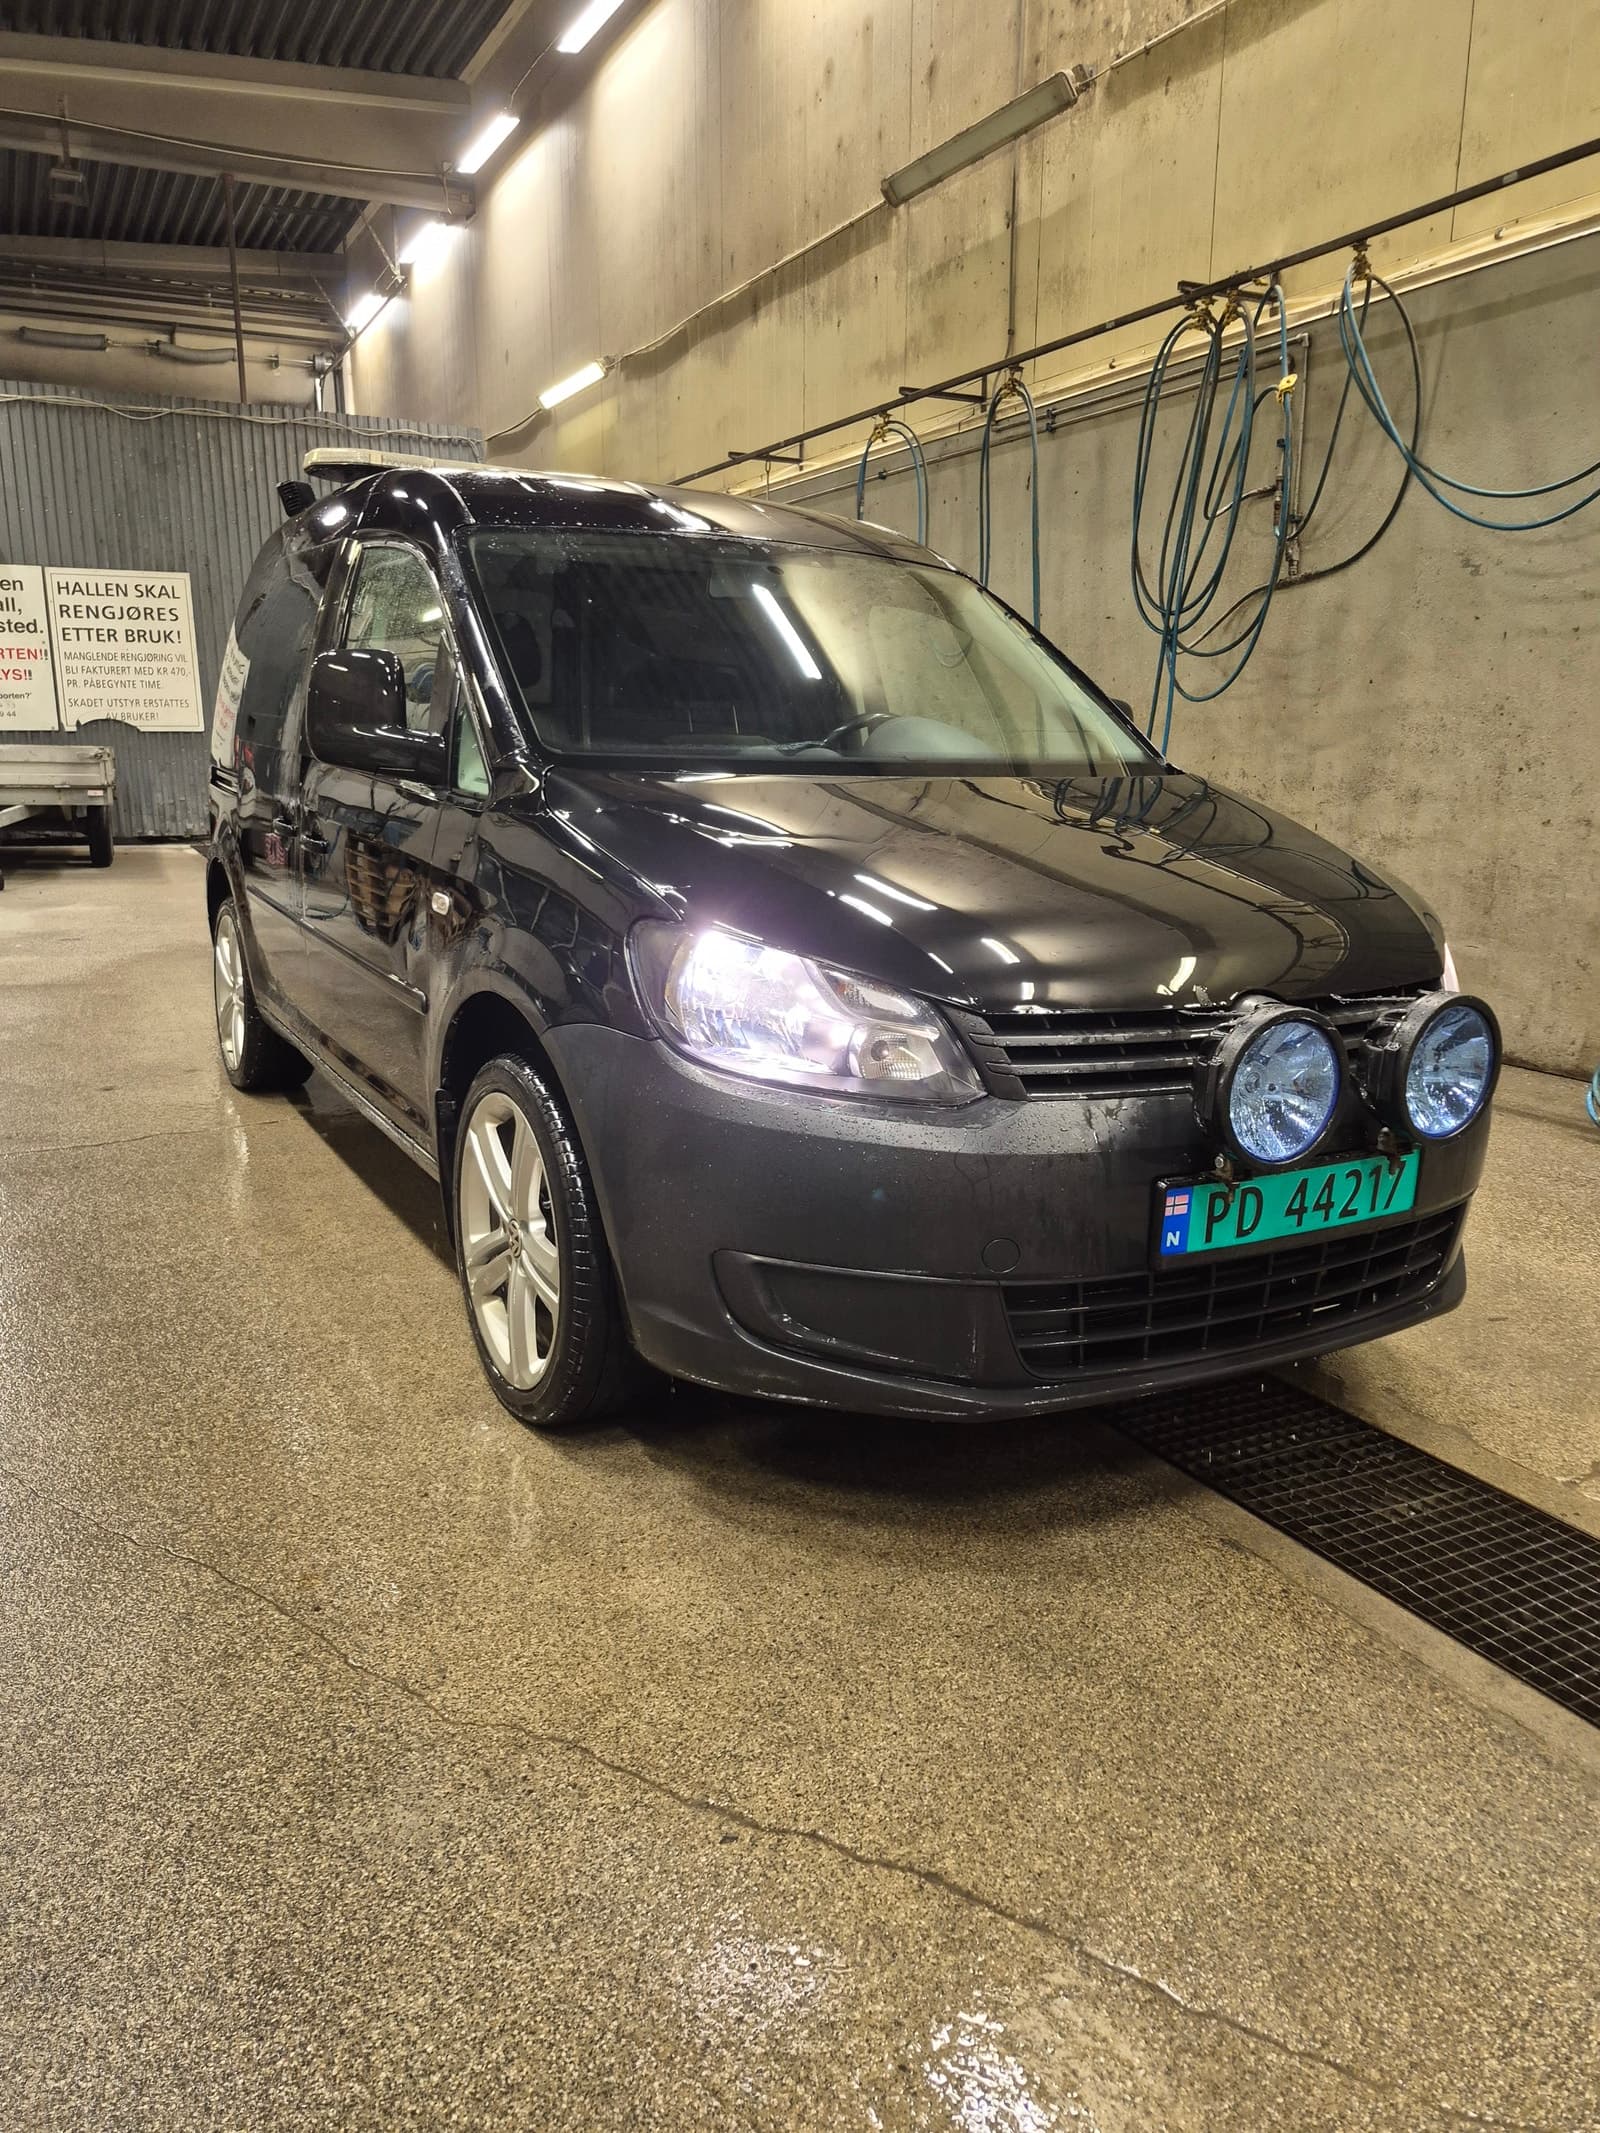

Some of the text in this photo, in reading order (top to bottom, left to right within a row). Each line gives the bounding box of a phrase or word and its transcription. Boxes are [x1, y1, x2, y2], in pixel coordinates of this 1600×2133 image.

[57, 581, 181, 599] HALLEN SKAL
[59, 604, 179, 622] RENGJØRES
[62, 627, 181, 644] ETTER BRUK!
[64, 651, 188, 663] MANGLENDE RENGJØRING VIL
[0, 669, 32, 681] YS!!
[65, 665, 79, 675] BLI
[81, 666, 131, 675] FAKTURERT
[135, 666, 154, 676] MED
[157, 667, 169, 676] KR
[84, 677, 137, 689] PÅBEGYNTE
[68, 698, 190, 708] SKADET UTSTYR ERSTATTES
[121, 712, 159, 721] BRUKER!
[1204, 1158, 1407, 1244] PD 44217
[1165, 1230, 1180, 1248] N
